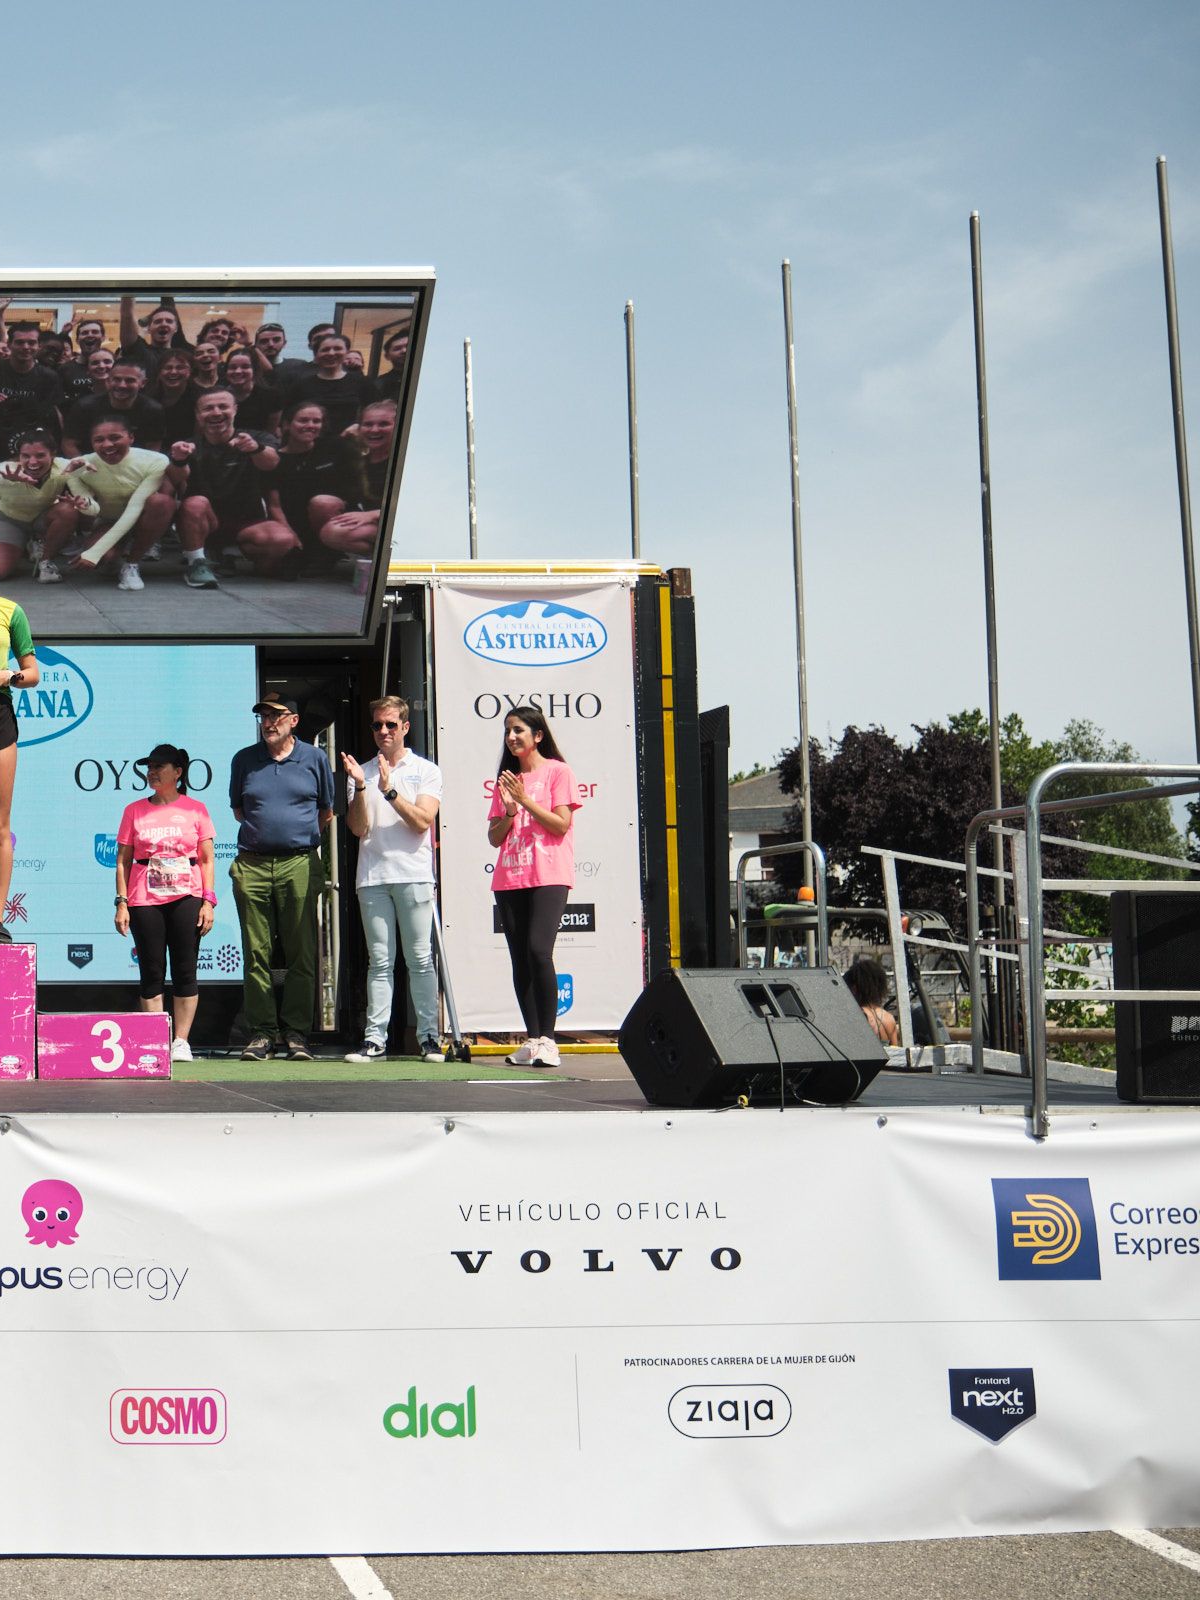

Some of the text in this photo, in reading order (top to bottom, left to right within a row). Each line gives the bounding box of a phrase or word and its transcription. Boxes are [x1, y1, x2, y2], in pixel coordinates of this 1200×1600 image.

[475, 625, 597, 650] ASTURIANA
[74, 758, 213, 792] OYSO
[214, 852, 237, 860] xpress
[90, 1020, 125, 1073] 3
[458, 1200, 727, 1222] VEHÍCULO OFICIAL
[1110, 1202, 1200, 1225] Correo
[1115, 1232, 1200, 1261] Expres
[450, 1247, 742, 1274] VOLVO
[68, 1267, 189, 1300] energy
[624, 1353, 856, 1367] PATROCINADORES CARRERA DE LA MUJER DE GIJÓN
[974, 1376, 1010, 1385] Fontarel
[963, 1388, 1024, 1407] next
[120, 1396, 218, 1435] COSMO
[383, 1384, 477, 1439] dial
